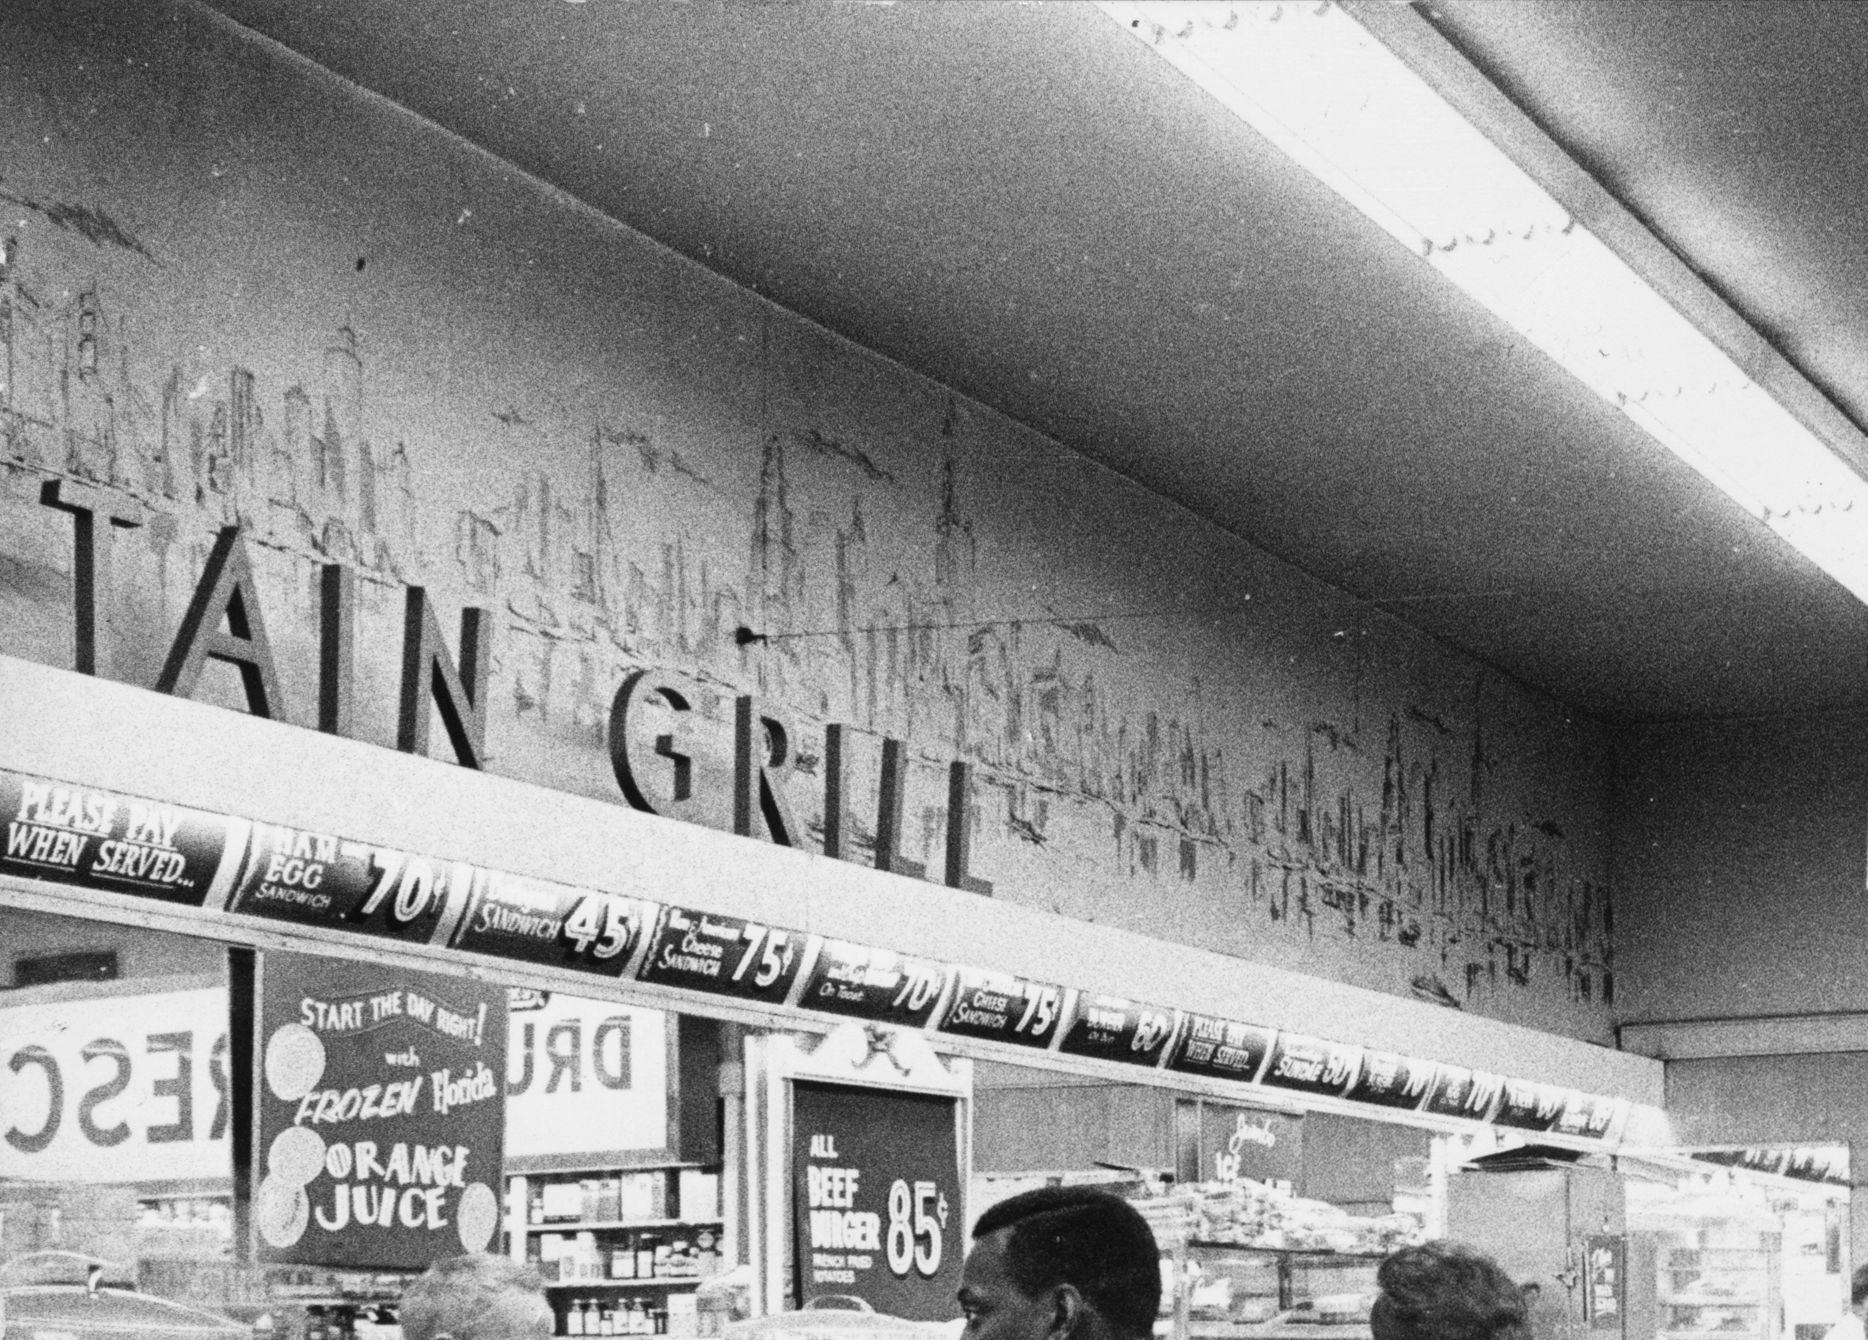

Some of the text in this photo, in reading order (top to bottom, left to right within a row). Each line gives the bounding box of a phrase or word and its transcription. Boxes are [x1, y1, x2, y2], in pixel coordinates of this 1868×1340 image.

[42, 479, 993, 897] TAIN GRILL
[15, 781, 185, 849] PLEASE PAY
[8, 821, 88, 866] WHEN
[265, 854, 324, 889] EGG
[255, 882, 332, 908] SANDWICH
[475, 902, 561, 942] SANDWICH
[657, 947, 722, 978] SANDWICH
[301, 992, 488, 1046] START THE DAY RIGHT!
[384, 1046, 421, 1067] with
[294, 1061, 497, 1126] FROZEN Florida
[325, 1141, 470, 1188] ORANGE
[810, 1134, 839, 1159] ALL
[315, 1184, 449, 1232] JUICE
[807, 1165, 860, 1208] BEEF
[810, 1210, 881, 1251] BURGER
[887, 1179, 949, 1276] 85¢
